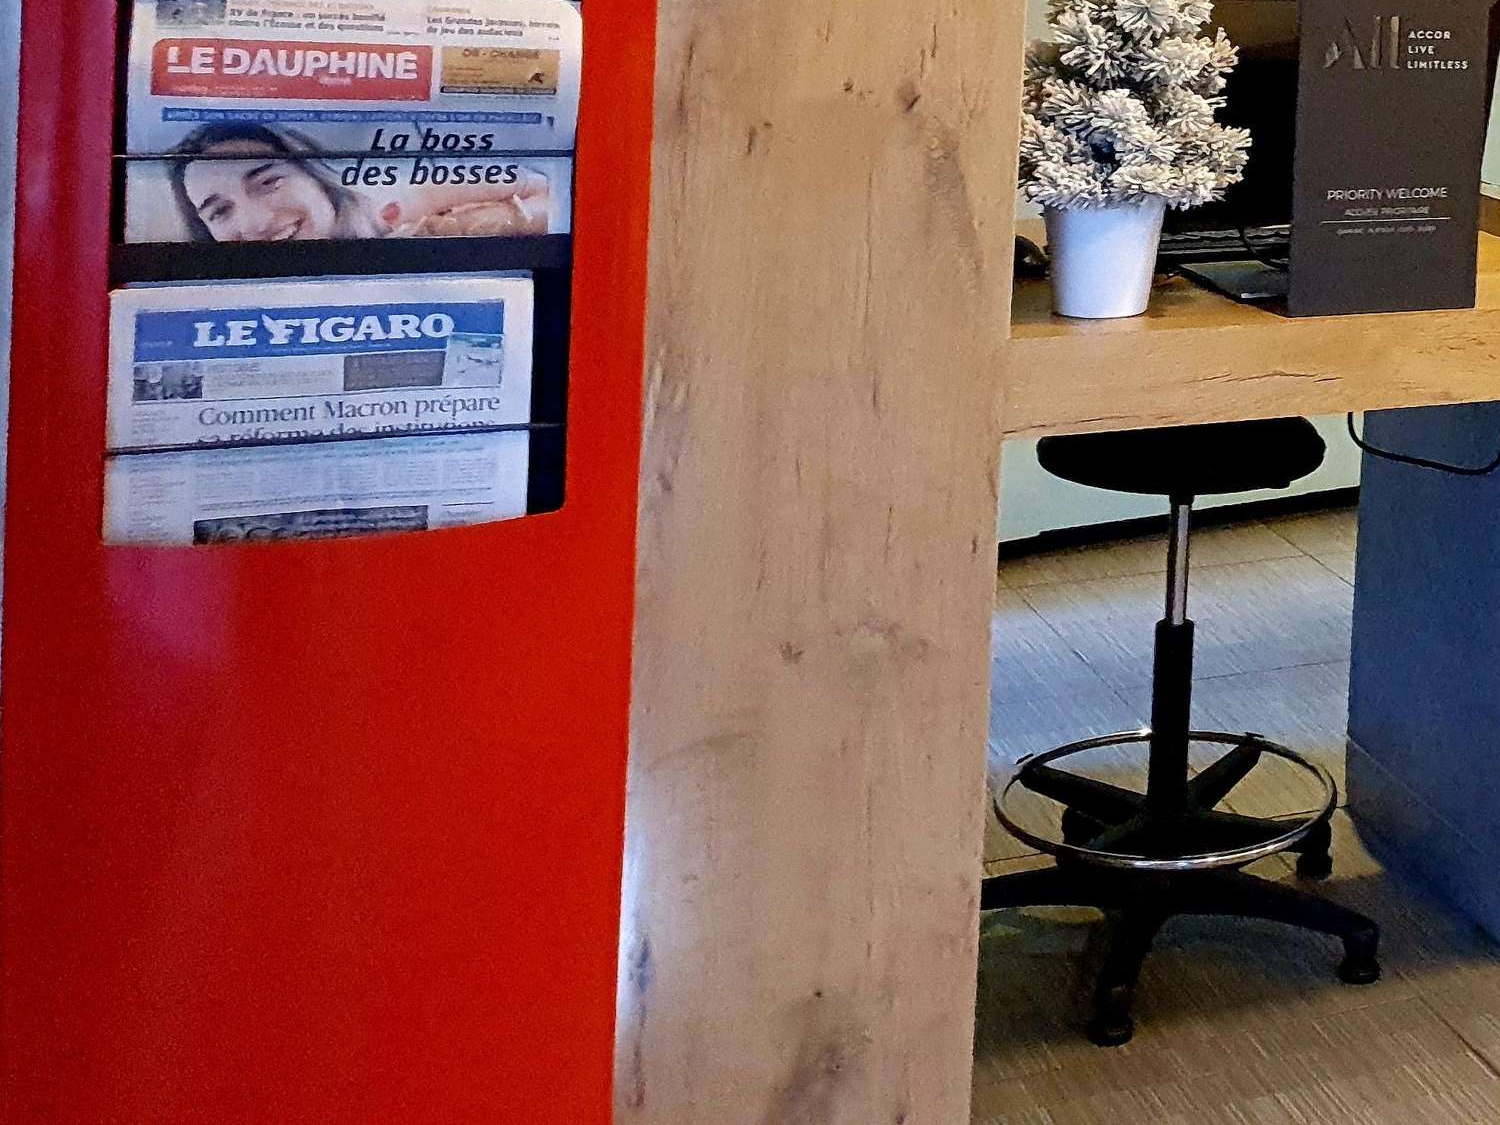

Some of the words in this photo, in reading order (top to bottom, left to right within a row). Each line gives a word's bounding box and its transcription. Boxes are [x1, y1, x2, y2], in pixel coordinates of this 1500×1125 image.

[1407, 30, 1451, 40] ACCOR
[167, 45, 215, 74] LE
[1407, 45, 1435, 55] LIVE
[1407, 60, 1469, 70] LIMITLESS
[370, 128, 410, 151] La
[420, 127, 494, 150] boss
[341, 156, 398, 186] des
[409, 156, 518, 185] bosses
[1327, 188, 1382, 201] PRIORITY
[1385, 186, 1448, 199] WELCOME
[193, 320, 258, 348] LE
[262, 313, 455, 345] FIGARO
[199, 405, 315, 426] Comment
[325, 397, 408, 420] Macron
[415, 394, 500, 417] prépare
